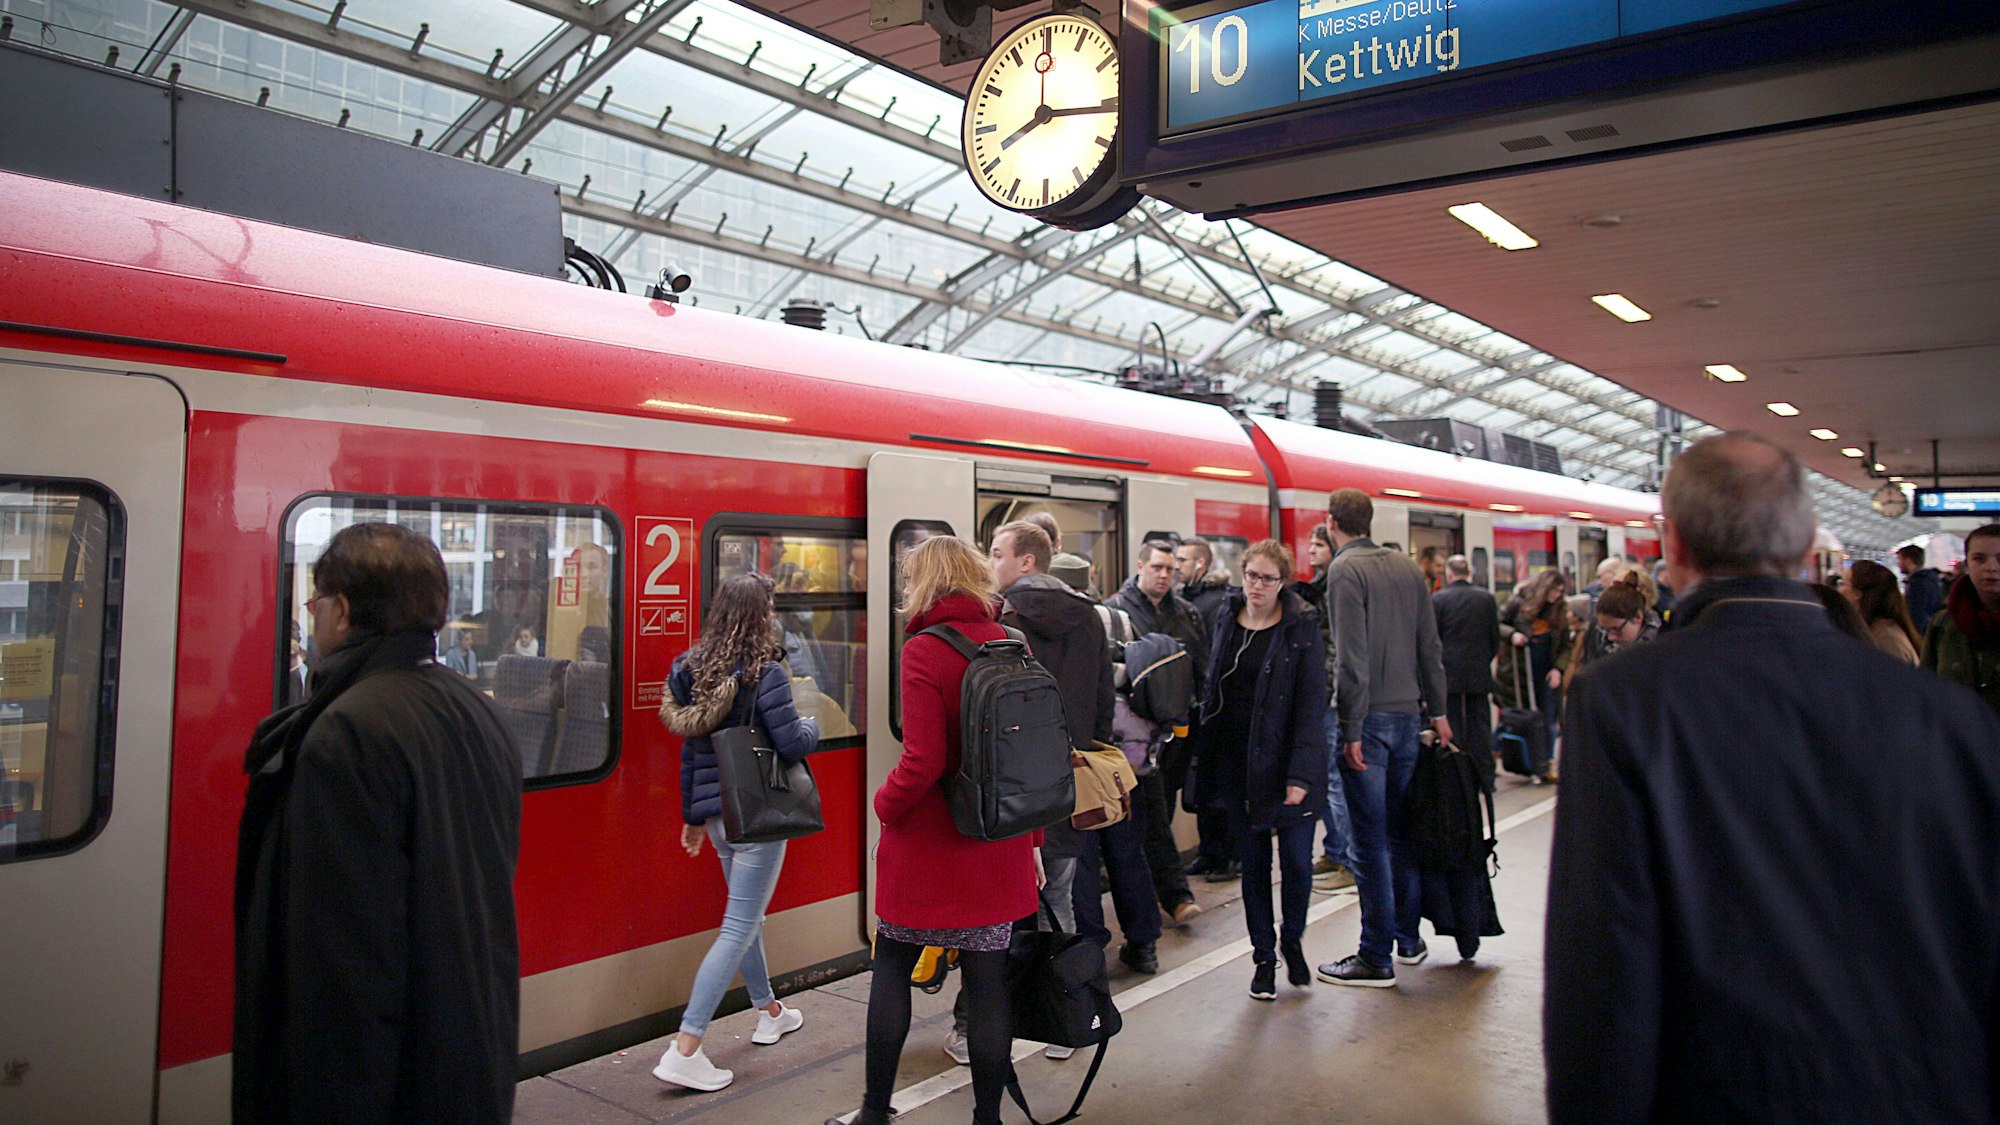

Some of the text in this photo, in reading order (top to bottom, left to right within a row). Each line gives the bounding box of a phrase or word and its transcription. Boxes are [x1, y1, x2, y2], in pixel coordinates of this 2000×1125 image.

[1175, 14, 1248, 94] 10
[1299, 23, 1311, 44] K
[1299, 24, 1460, 90] Kettwig
[644, 524, 681, 595] 2
